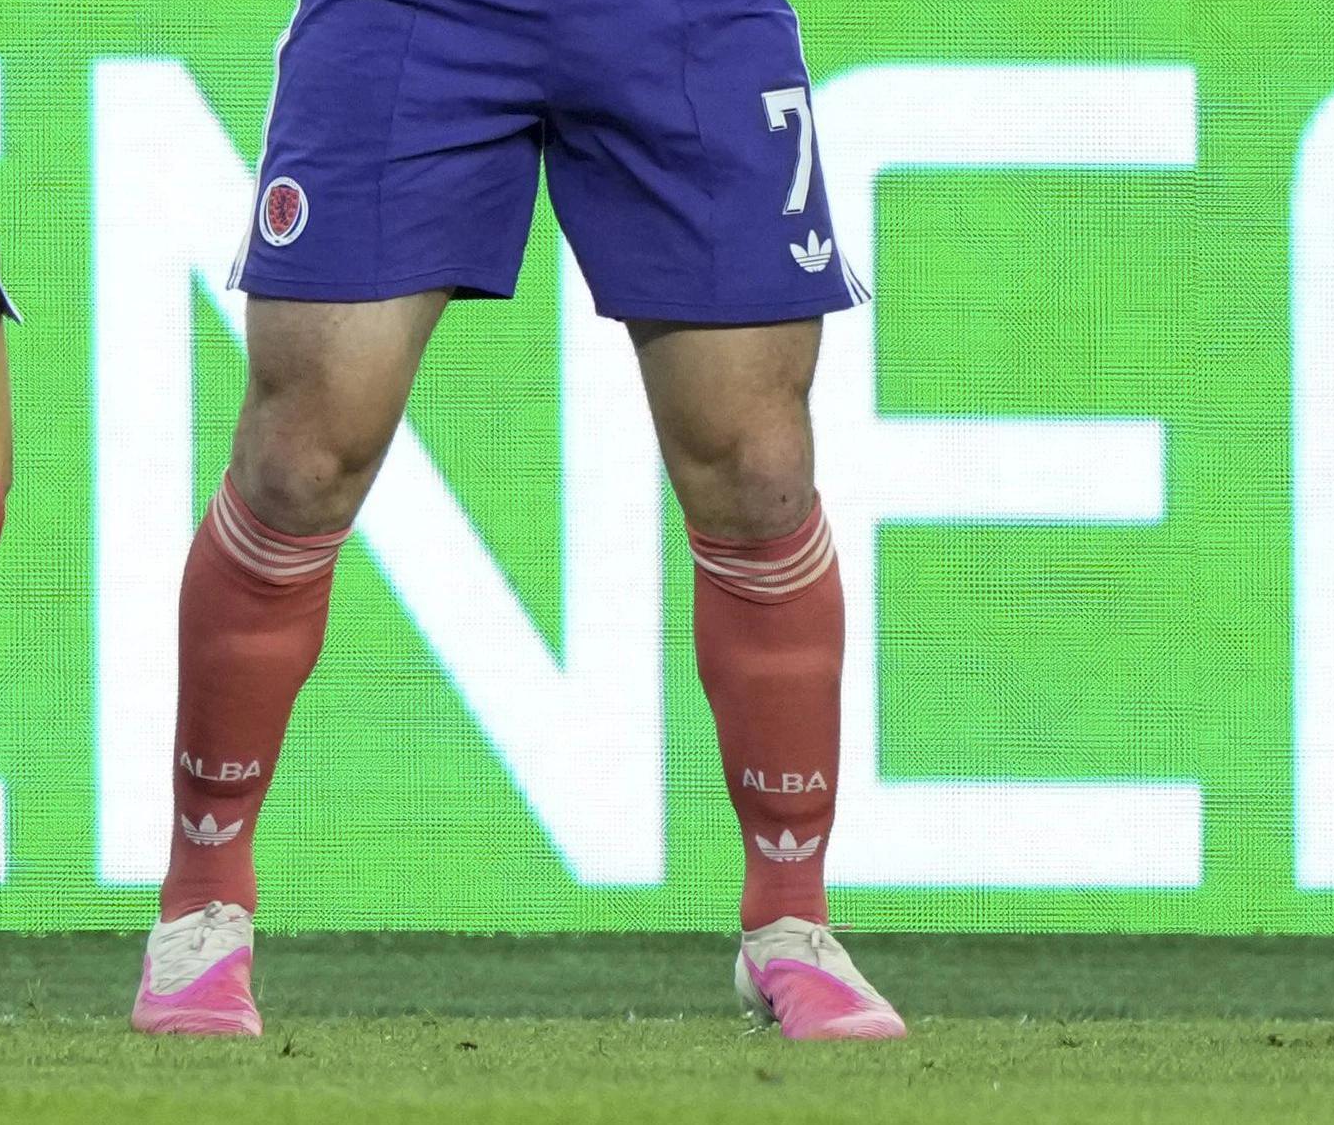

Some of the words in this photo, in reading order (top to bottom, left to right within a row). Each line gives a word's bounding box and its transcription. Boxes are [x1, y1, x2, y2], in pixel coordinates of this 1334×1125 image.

[761, 86, 812, 216] 7
[180, 751, 261, 781] ALBA
[742, 768, 827, 794] ALBA
